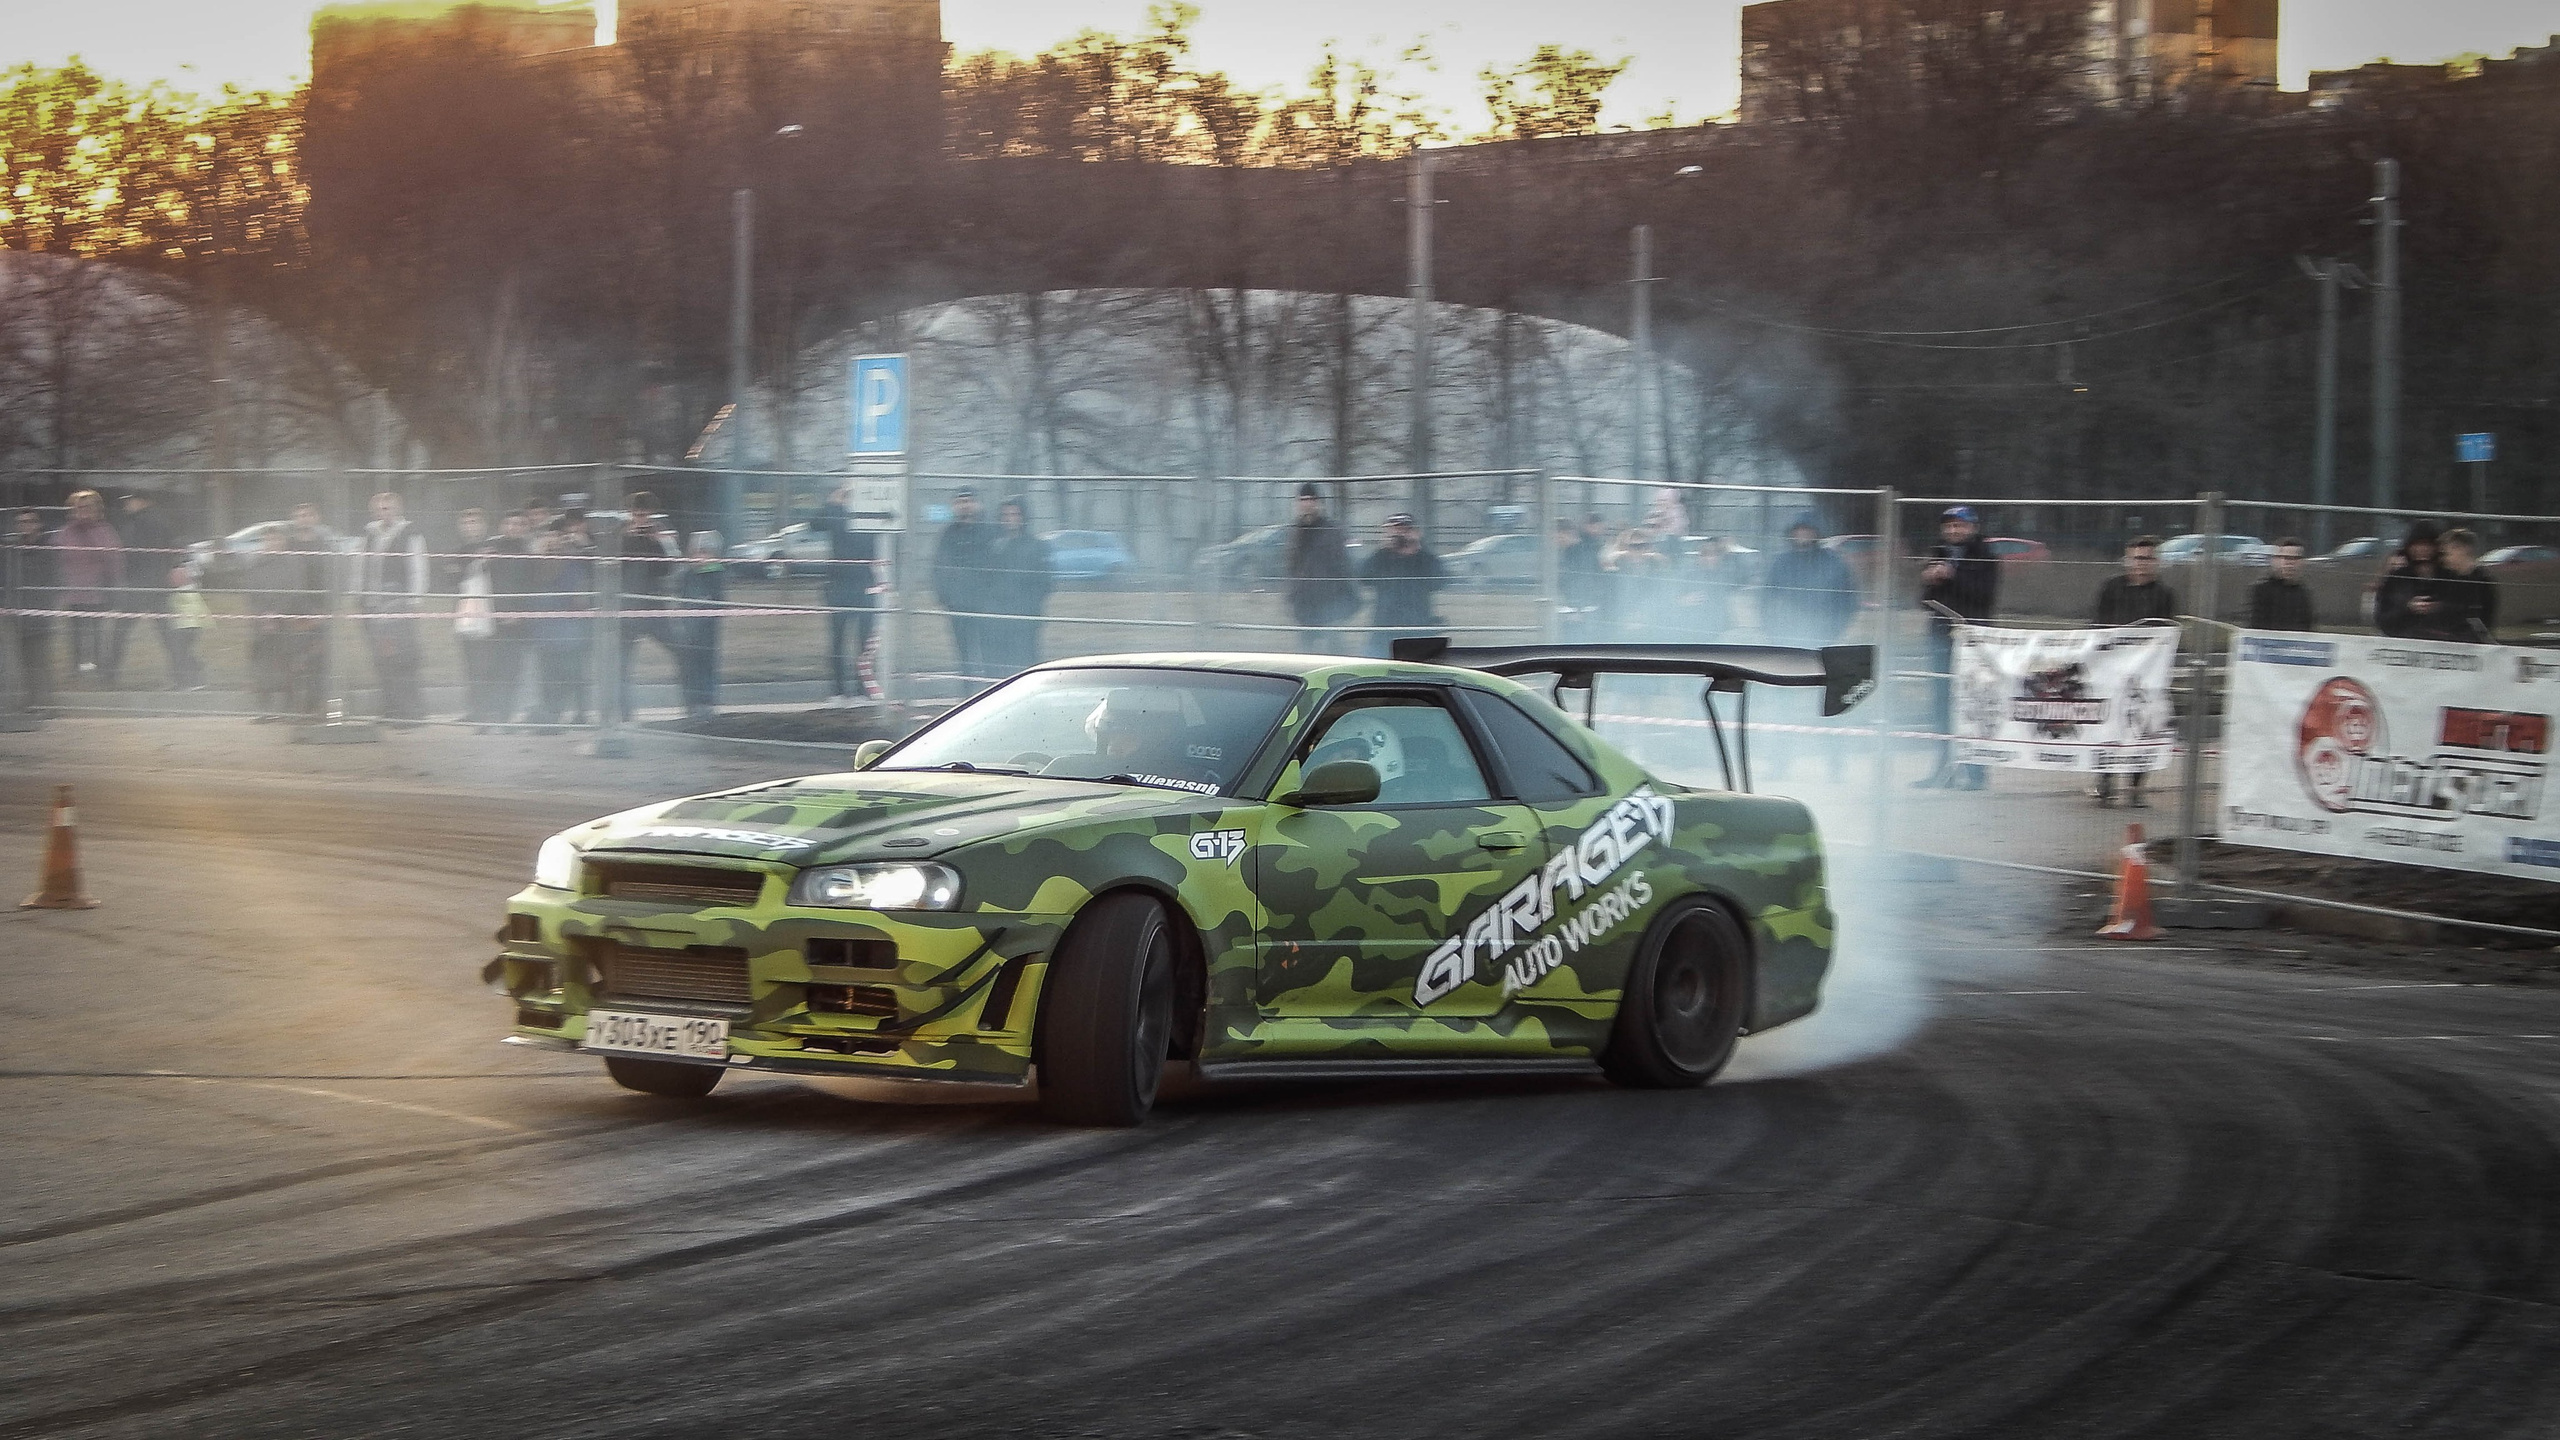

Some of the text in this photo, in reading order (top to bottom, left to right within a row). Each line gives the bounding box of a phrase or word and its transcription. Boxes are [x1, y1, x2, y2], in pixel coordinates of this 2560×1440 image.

[862, 368, 900, 444] P
[1502, 870, 1653, 998] AUTO WORKS
